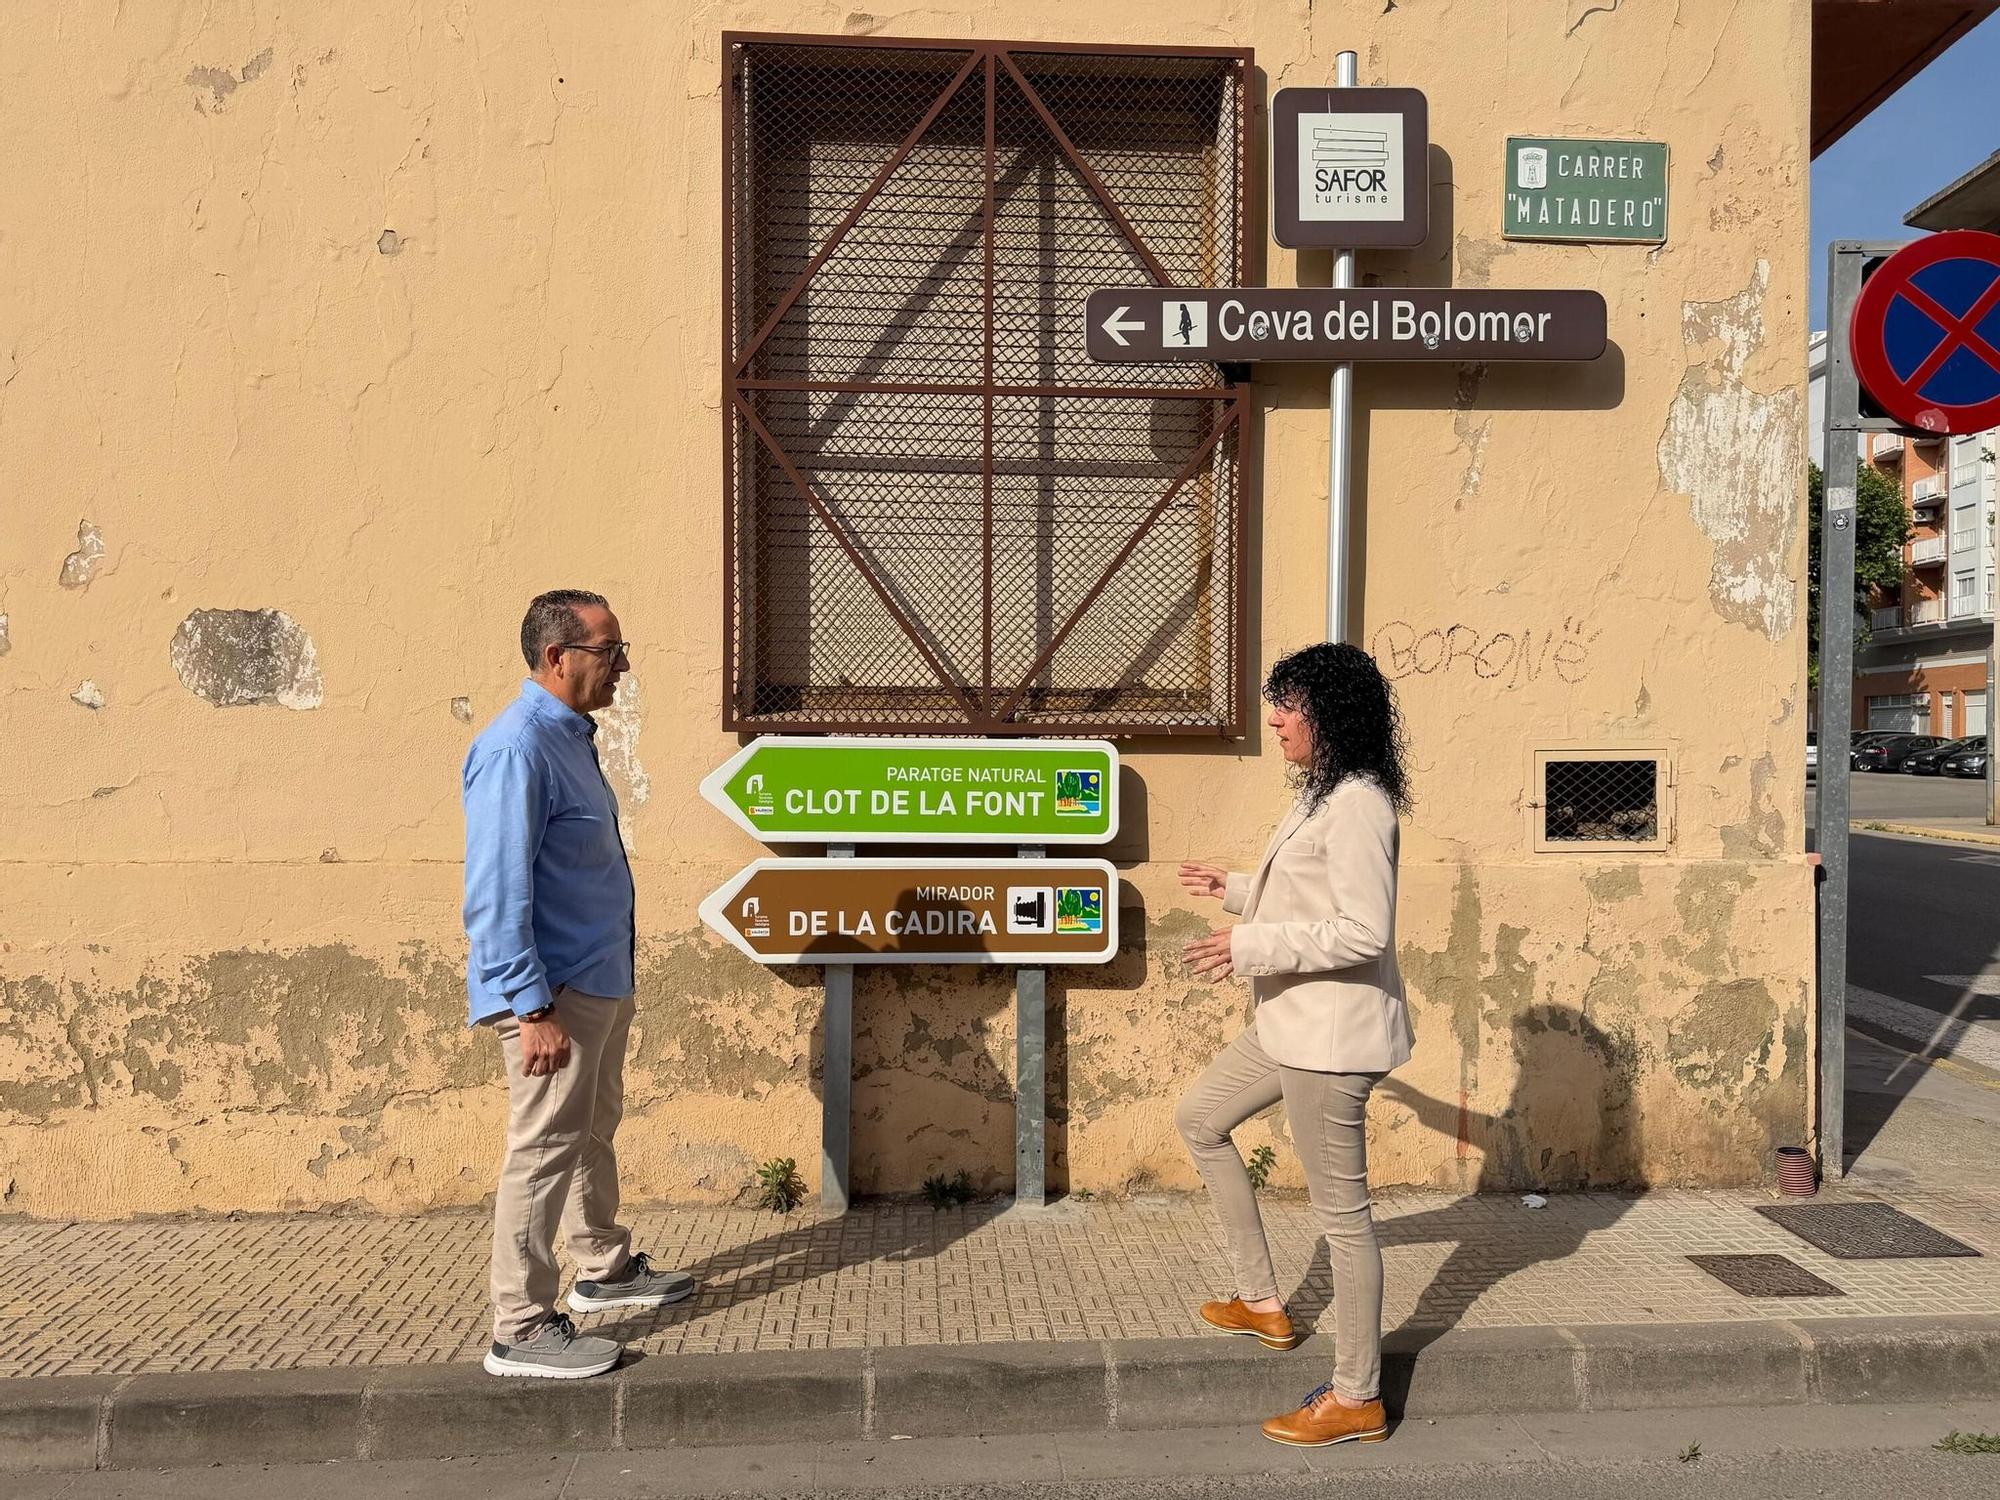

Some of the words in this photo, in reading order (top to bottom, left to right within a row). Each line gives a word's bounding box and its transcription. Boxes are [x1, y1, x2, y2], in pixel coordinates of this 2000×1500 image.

[1558, 155, 1644, 179] CARRER
[1315, 168, 1388, 192] SAFOR
[1315, 193, 1388, 204] turisme
[1508, 193, 1662, 228] "MATADERO"
[1218, 299, 1313, 342] Cova
[1323, 300, 1378, 342] del
[1392, 300, 1552, 343] Bolomor
[886, 767, 963, 783] PARATGE
[968, 767, 1047, 784] NATURAL
[785, 788, 862, 815] CLOT
[870, 789, 909, 815] DE
[919, 789, 957, 816] LA
[966, 790, 1045, 817] FONT
[916, 886, 995, 902] MIRADOR
[788, 910, 827, 936] DE
[838, 910, 876, 936] LA
[884, 910, 998, 937] CADIRA
